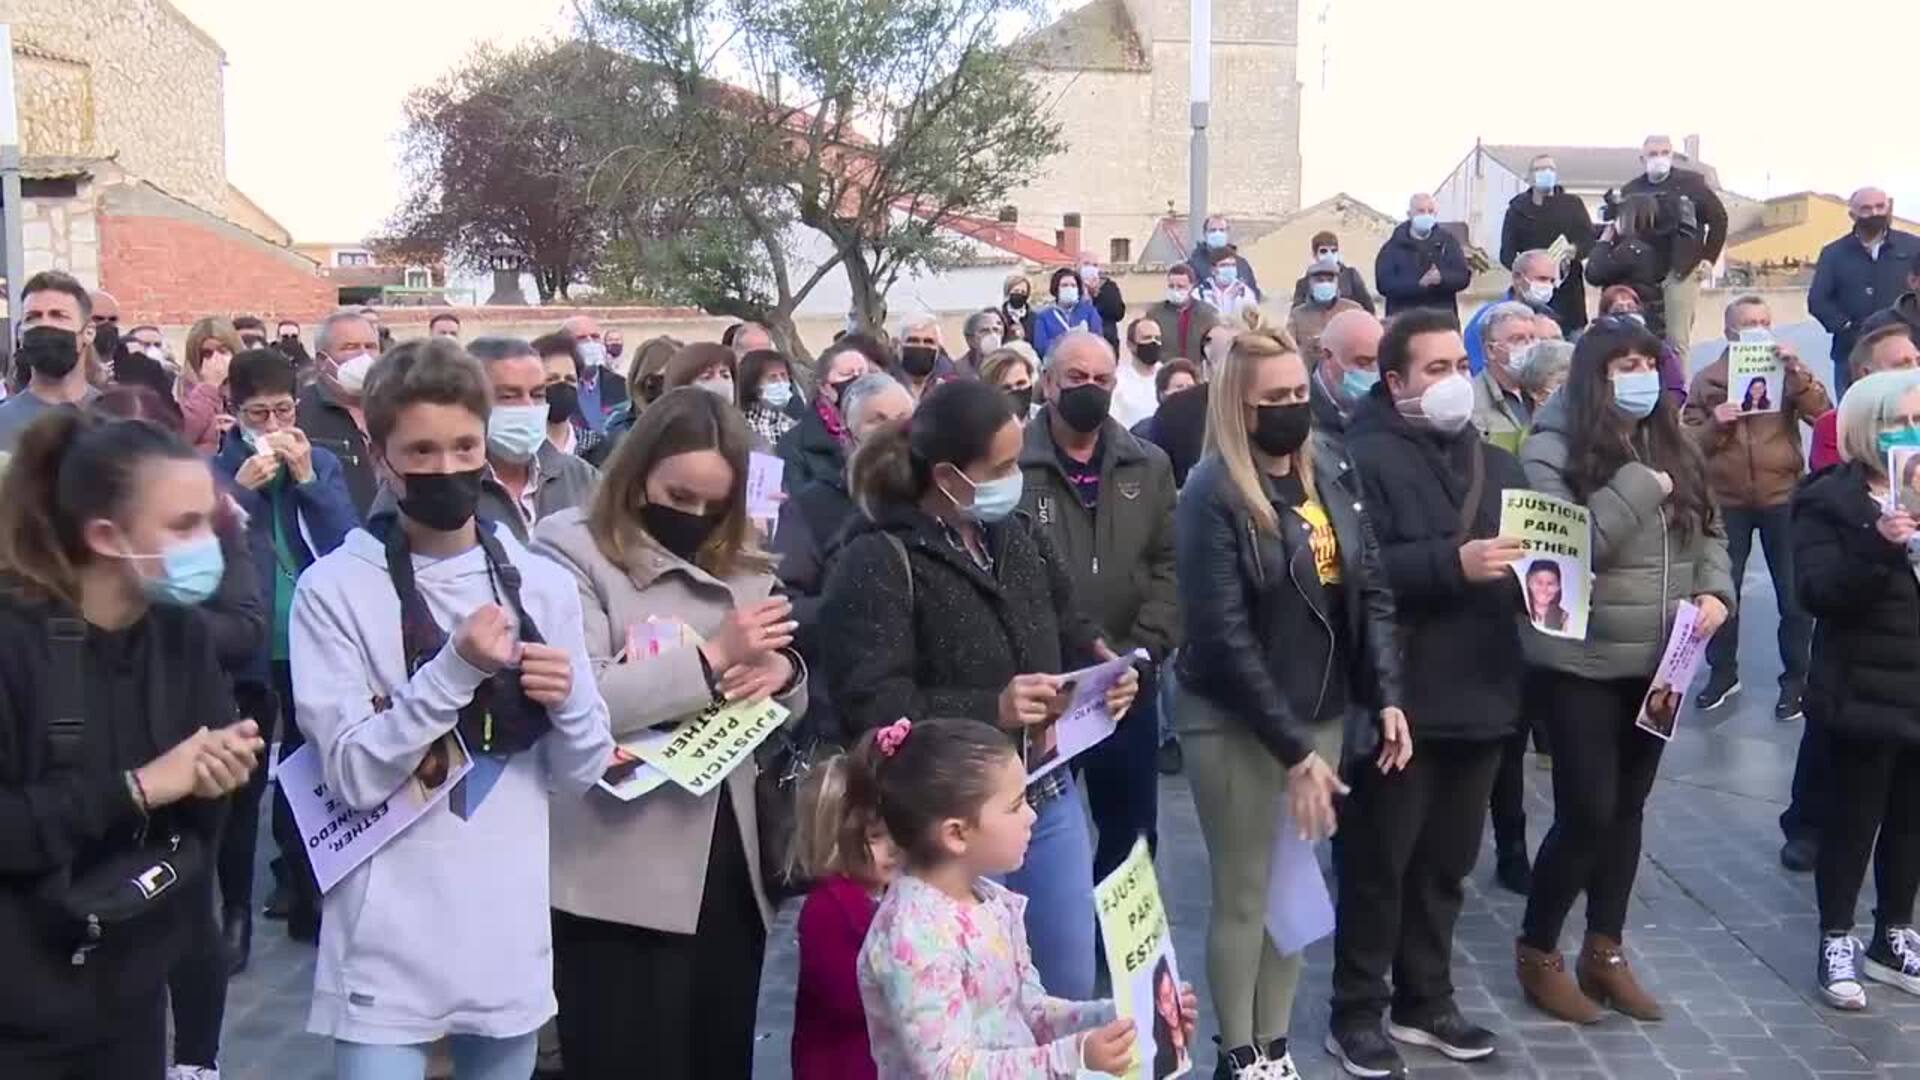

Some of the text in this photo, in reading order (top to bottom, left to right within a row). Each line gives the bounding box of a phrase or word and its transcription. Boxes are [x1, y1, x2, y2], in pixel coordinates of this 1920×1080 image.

[1507, 498, 1587, 525] #JUSTICIA
[1524, 519, 1569, 537] PARA
[1521, 539, 1579, 557] STHER
[689, 709, 777, 788] #JUSTICIA
[691, 717, 739, 759] PARA
